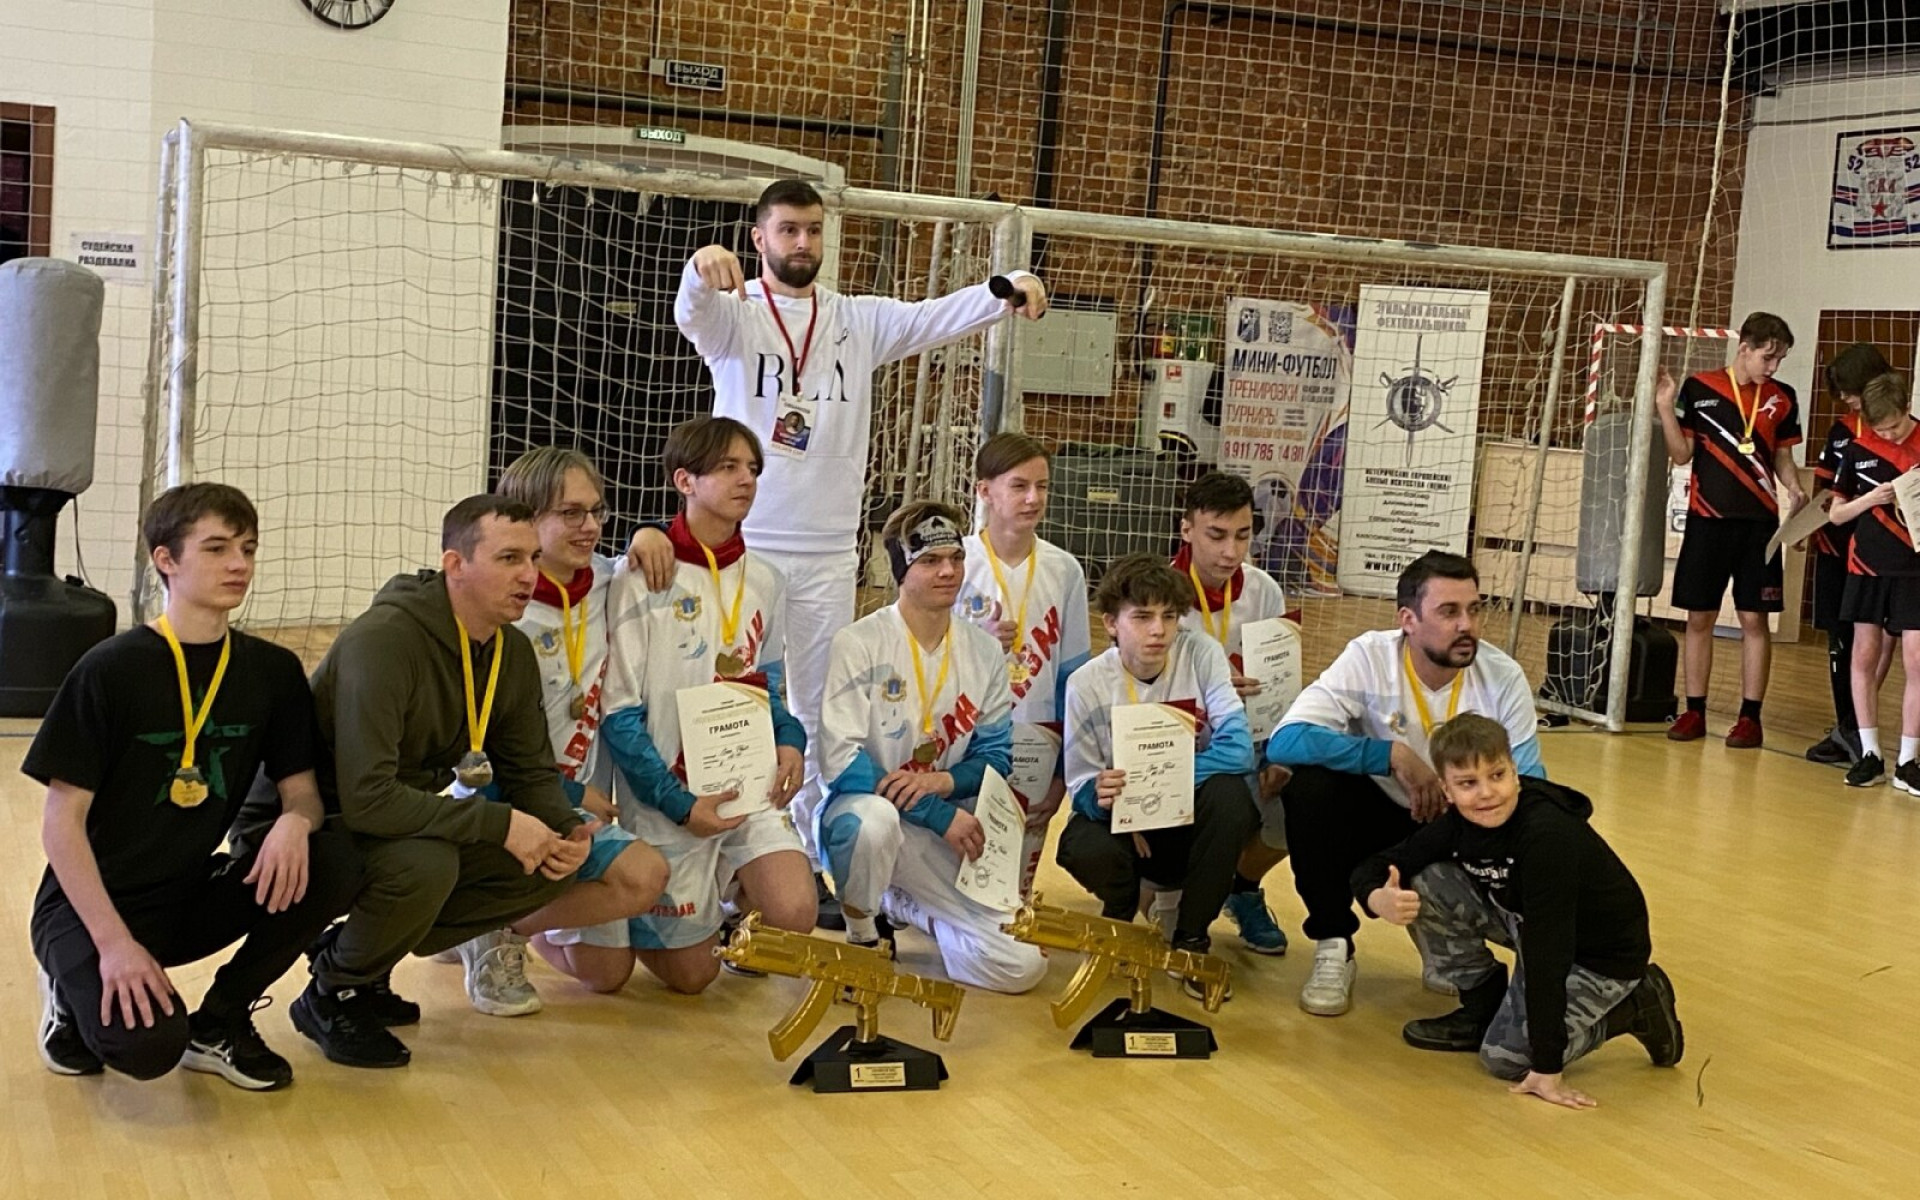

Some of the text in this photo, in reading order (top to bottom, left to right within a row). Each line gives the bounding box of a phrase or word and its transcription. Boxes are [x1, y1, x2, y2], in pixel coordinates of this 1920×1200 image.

[674, 63, 720, 79] ВЫХОД
[639, 127, 682, 143] ВЫХОД
[1847, 154, 1865, 175] 52
[80, 240, 134, 253] СУДЕЙСКАЯ
[78, 254, 137, 268] РАЗДЕВАЛКА
[1231, 347, 1338, 380] МИНИ-ФУТБОЛ
[1228, 378, 1300, 403] ТРЕНИРОВКИ
[1226, 403, 1280, 426] ТУРНИРЫ
[1264, 650, 1290, 663] ГРАМОТА
[709, 719, 750, 734] ГРАМОТА
[1138, 740, 1175, 752] ГРАМОТА
[856, 1066, 861, 1079] 1
